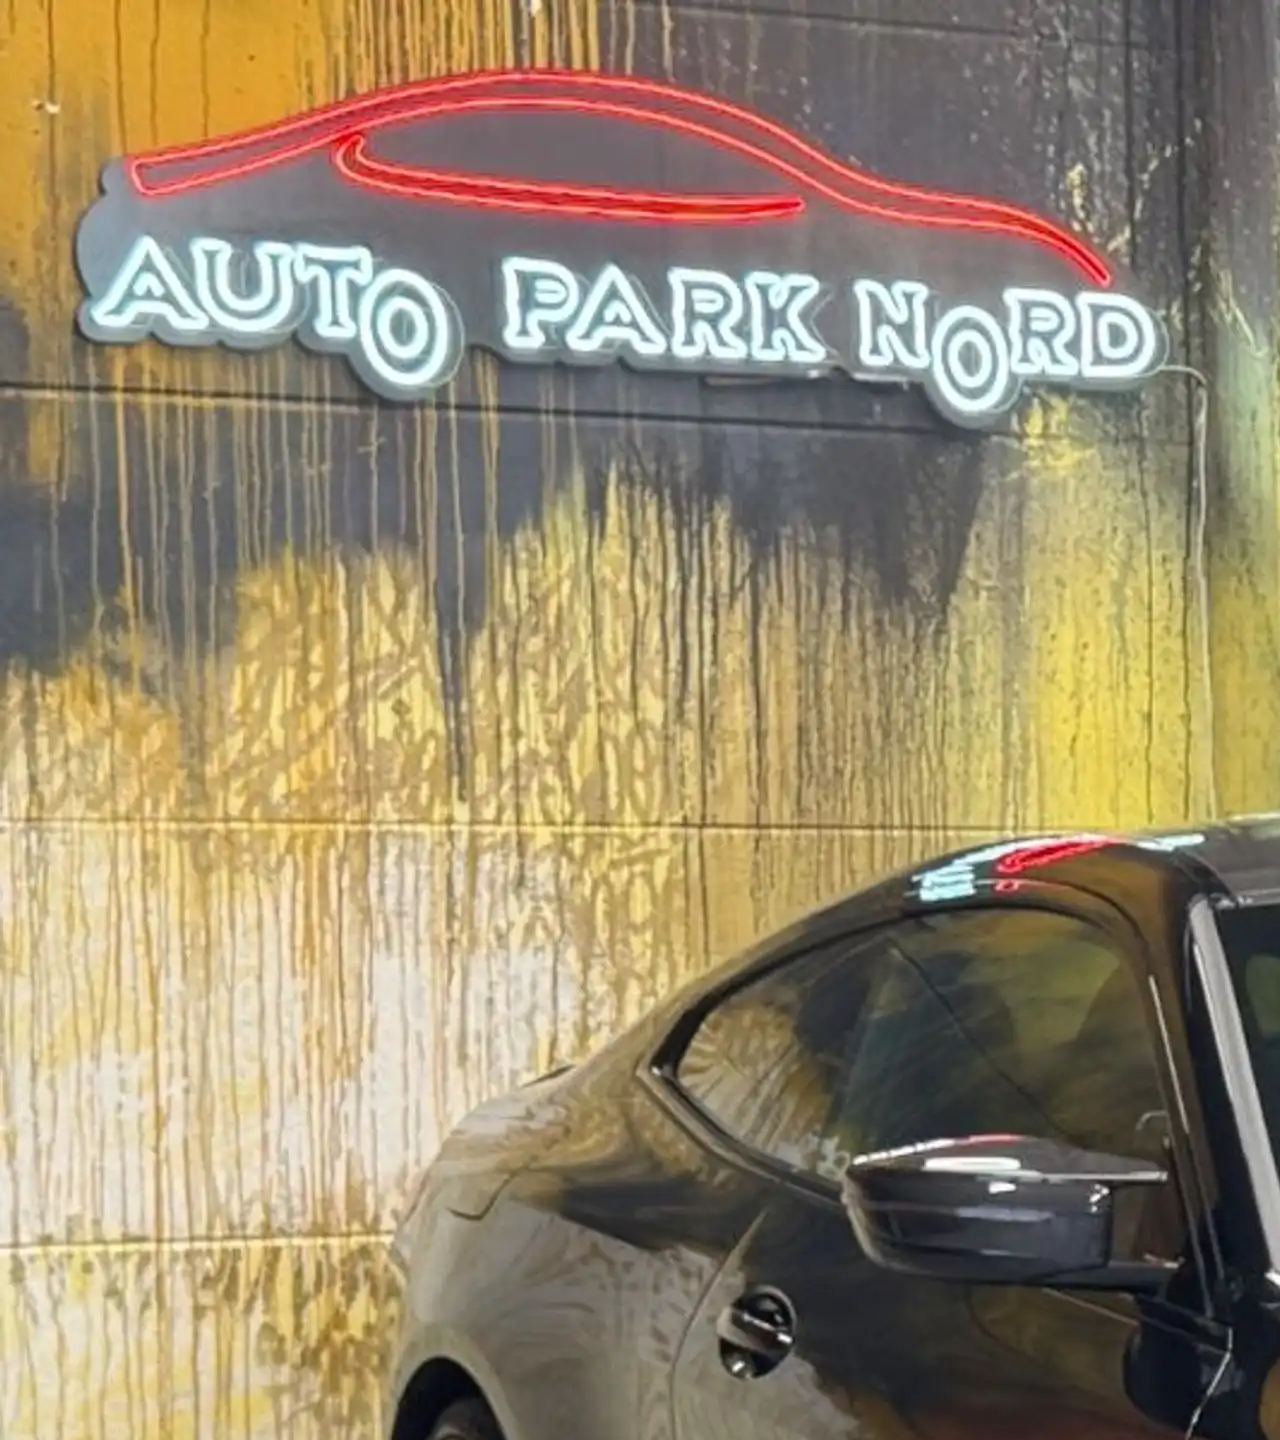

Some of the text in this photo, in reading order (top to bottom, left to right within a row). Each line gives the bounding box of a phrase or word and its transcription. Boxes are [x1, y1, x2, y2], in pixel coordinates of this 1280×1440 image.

[90, 236, 1160, 415] AUTO PARK NORD
